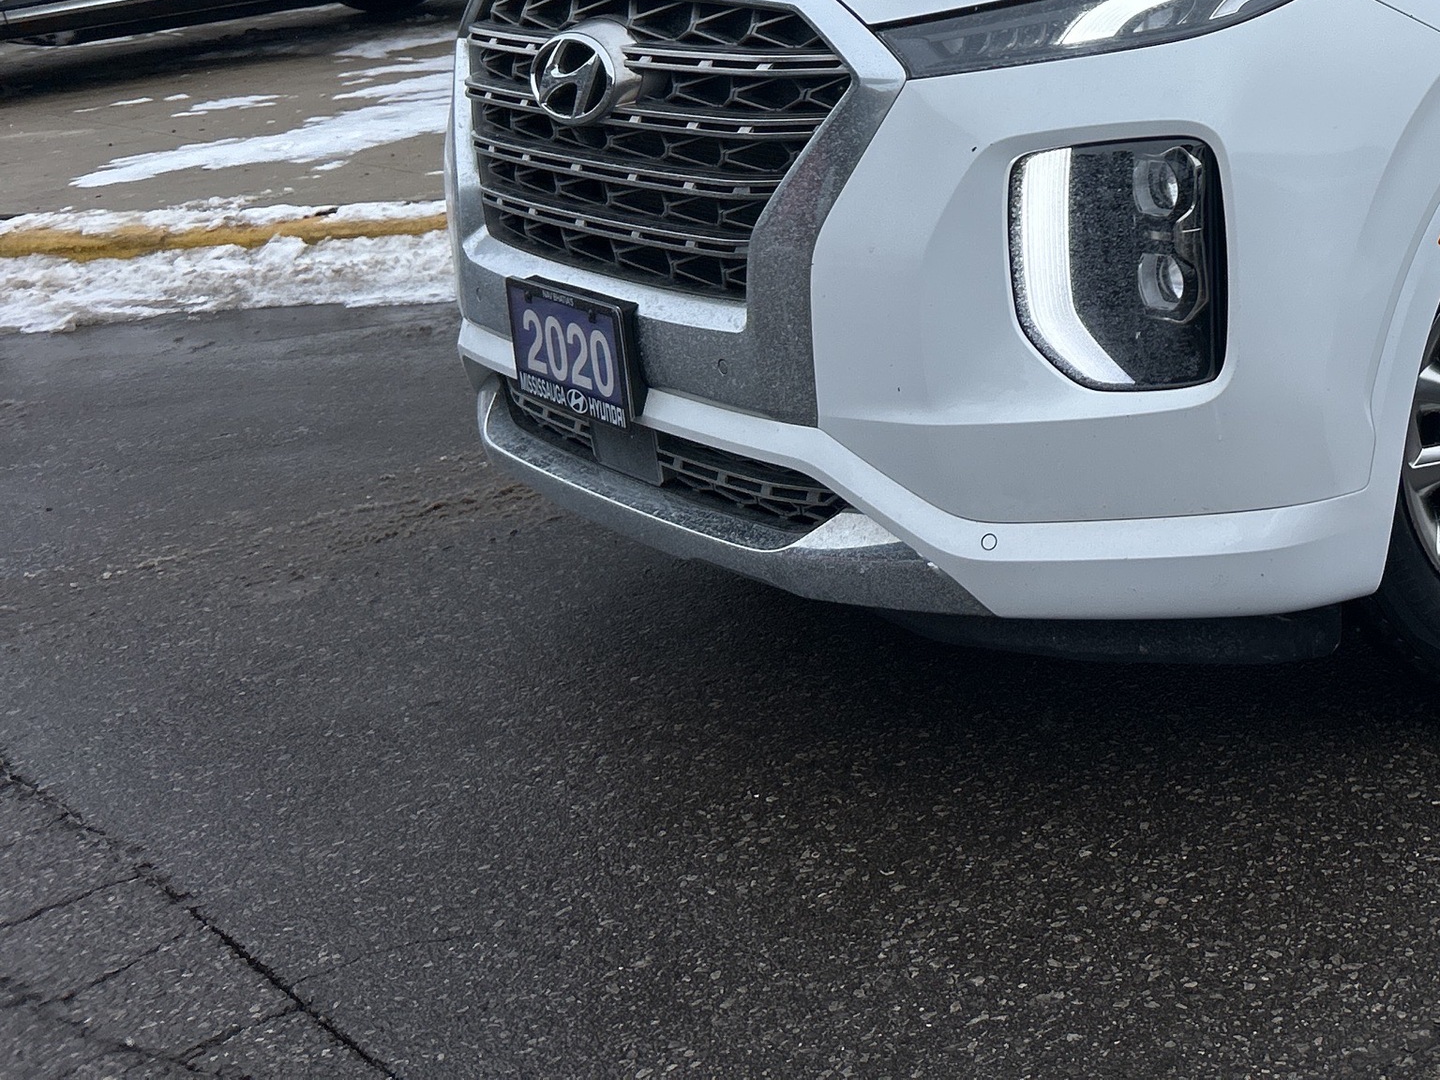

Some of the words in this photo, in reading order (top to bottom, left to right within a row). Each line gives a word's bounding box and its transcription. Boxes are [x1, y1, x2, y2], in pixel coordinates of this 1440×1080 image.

[523, 309, 614, 398] 2020
[519, 371, 567, 407] MISSISSAUGA
[588, 396, 627, 429] HYUNDAI
